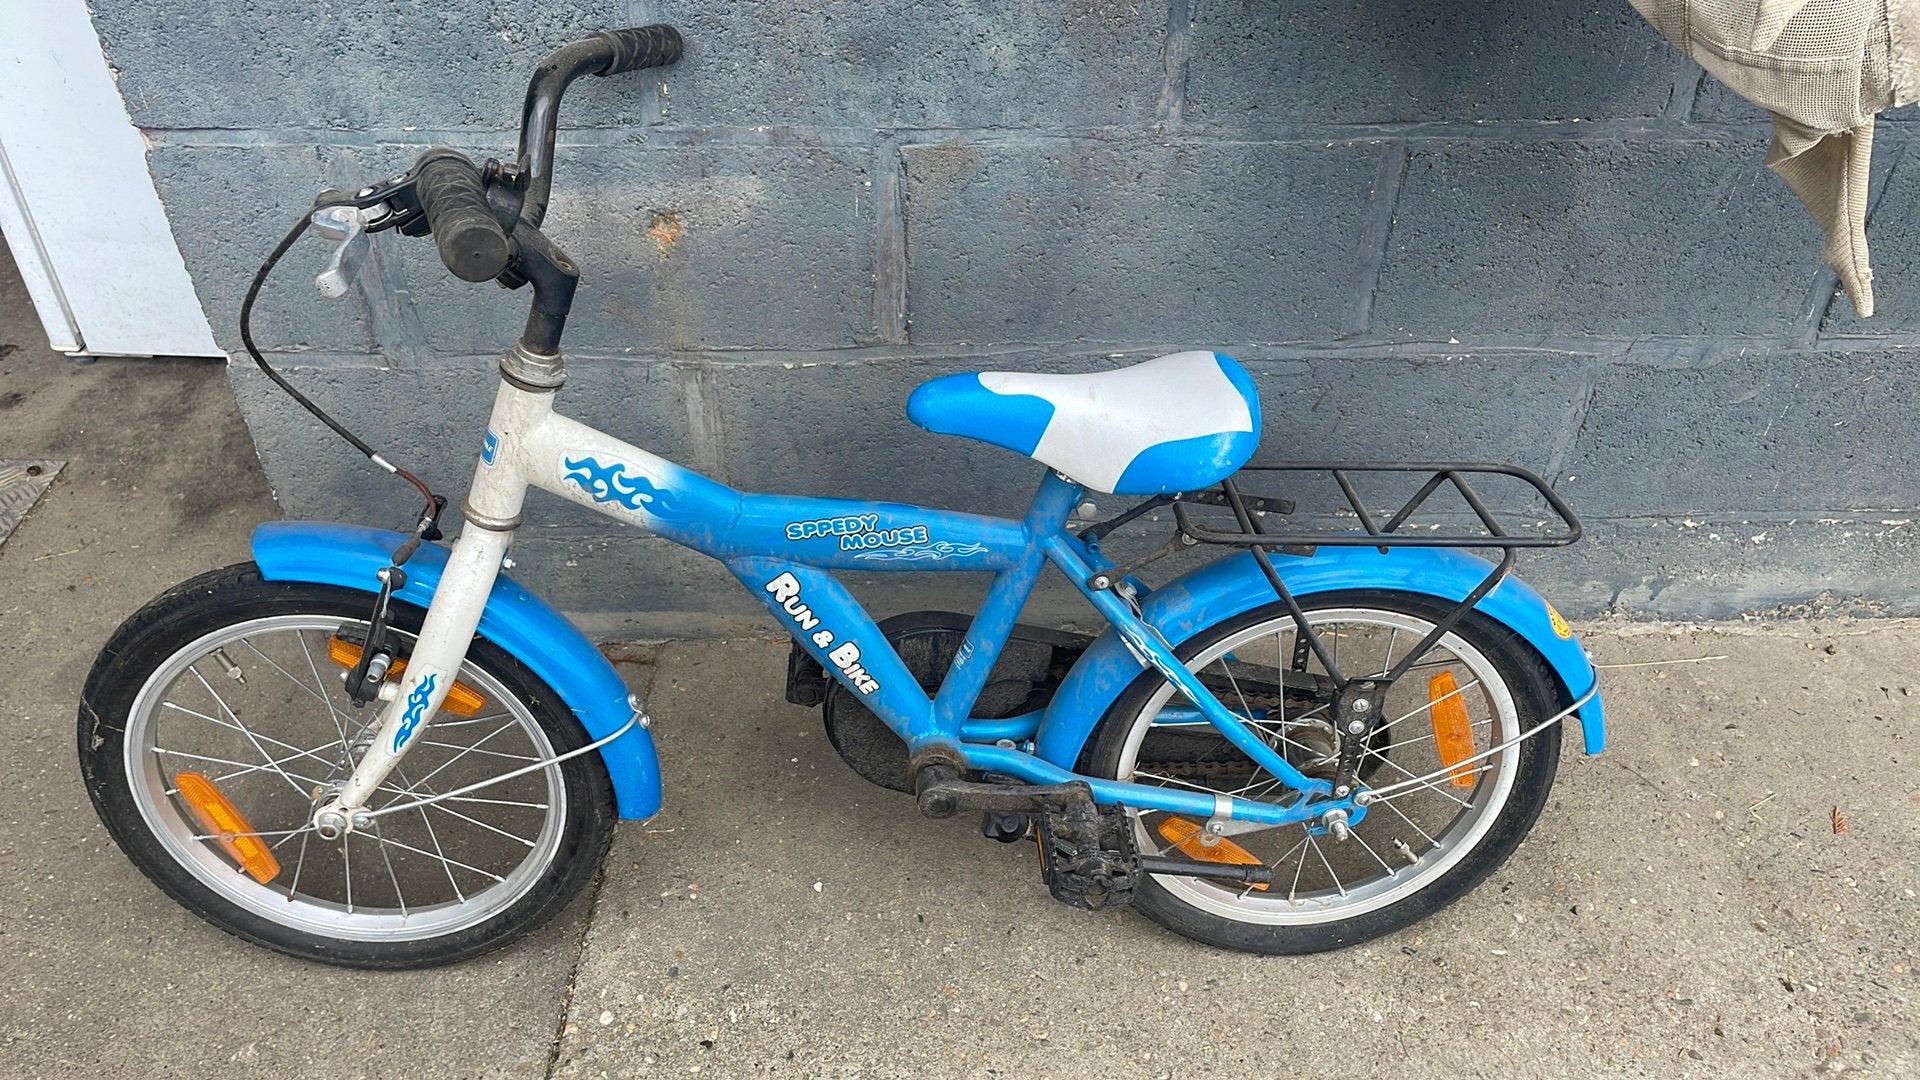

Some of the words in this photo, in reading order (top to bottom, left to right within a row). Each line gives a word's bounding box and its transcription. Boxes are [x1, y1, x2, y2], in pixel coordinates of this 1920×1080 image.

[786, 514, 878, 540] SPPEDY
[840, 526, 929, 551] MOUSE
[812, 630, 835, 649] &
